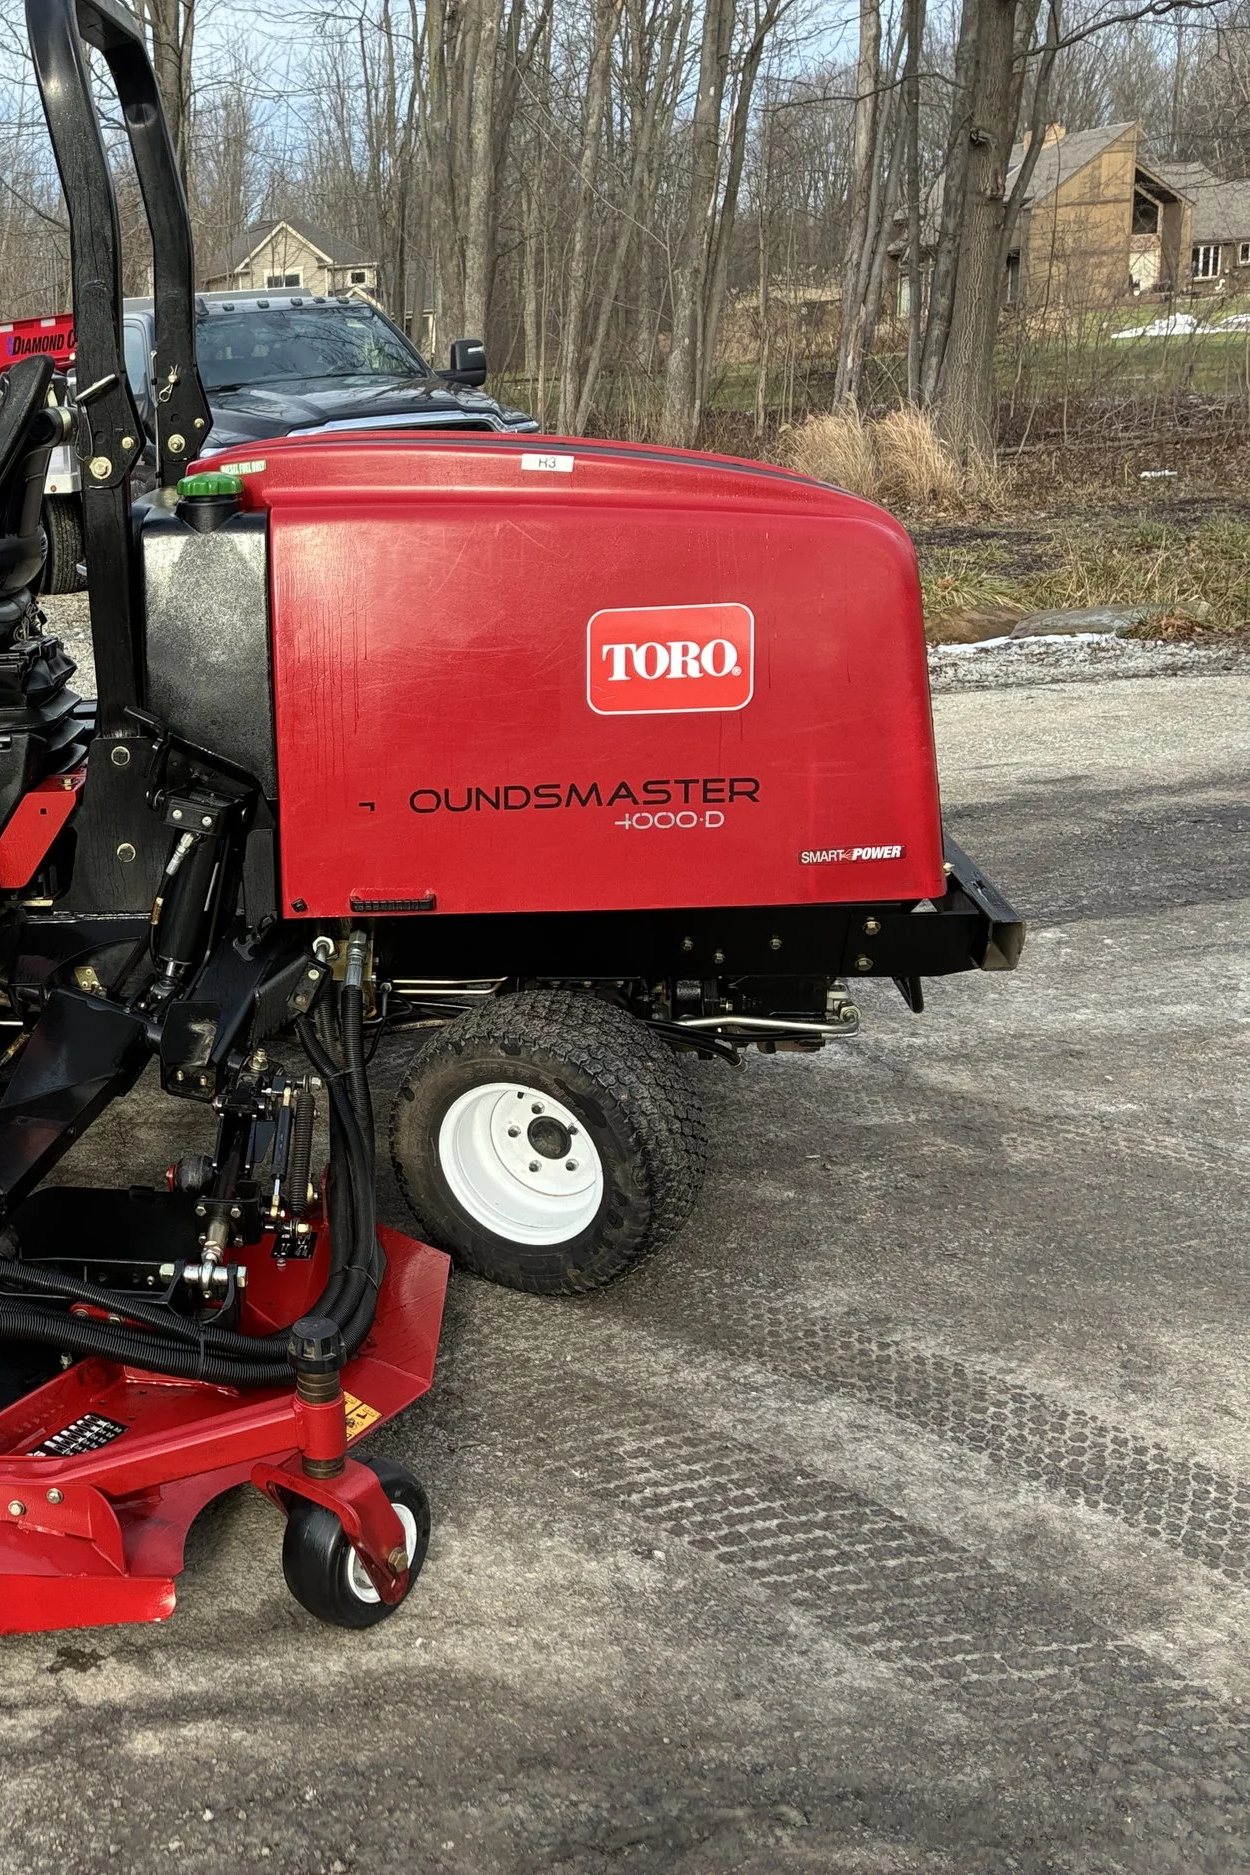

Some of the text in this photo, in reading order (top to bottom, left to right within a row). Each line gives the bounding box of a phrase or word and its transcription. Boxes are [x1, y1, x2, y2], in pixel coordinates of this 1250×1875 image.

[13, 333, 65, 355] DIAMOND
[602, 638, 738, 681] TORO
[801, 845, 902, 864] SMART POWER
